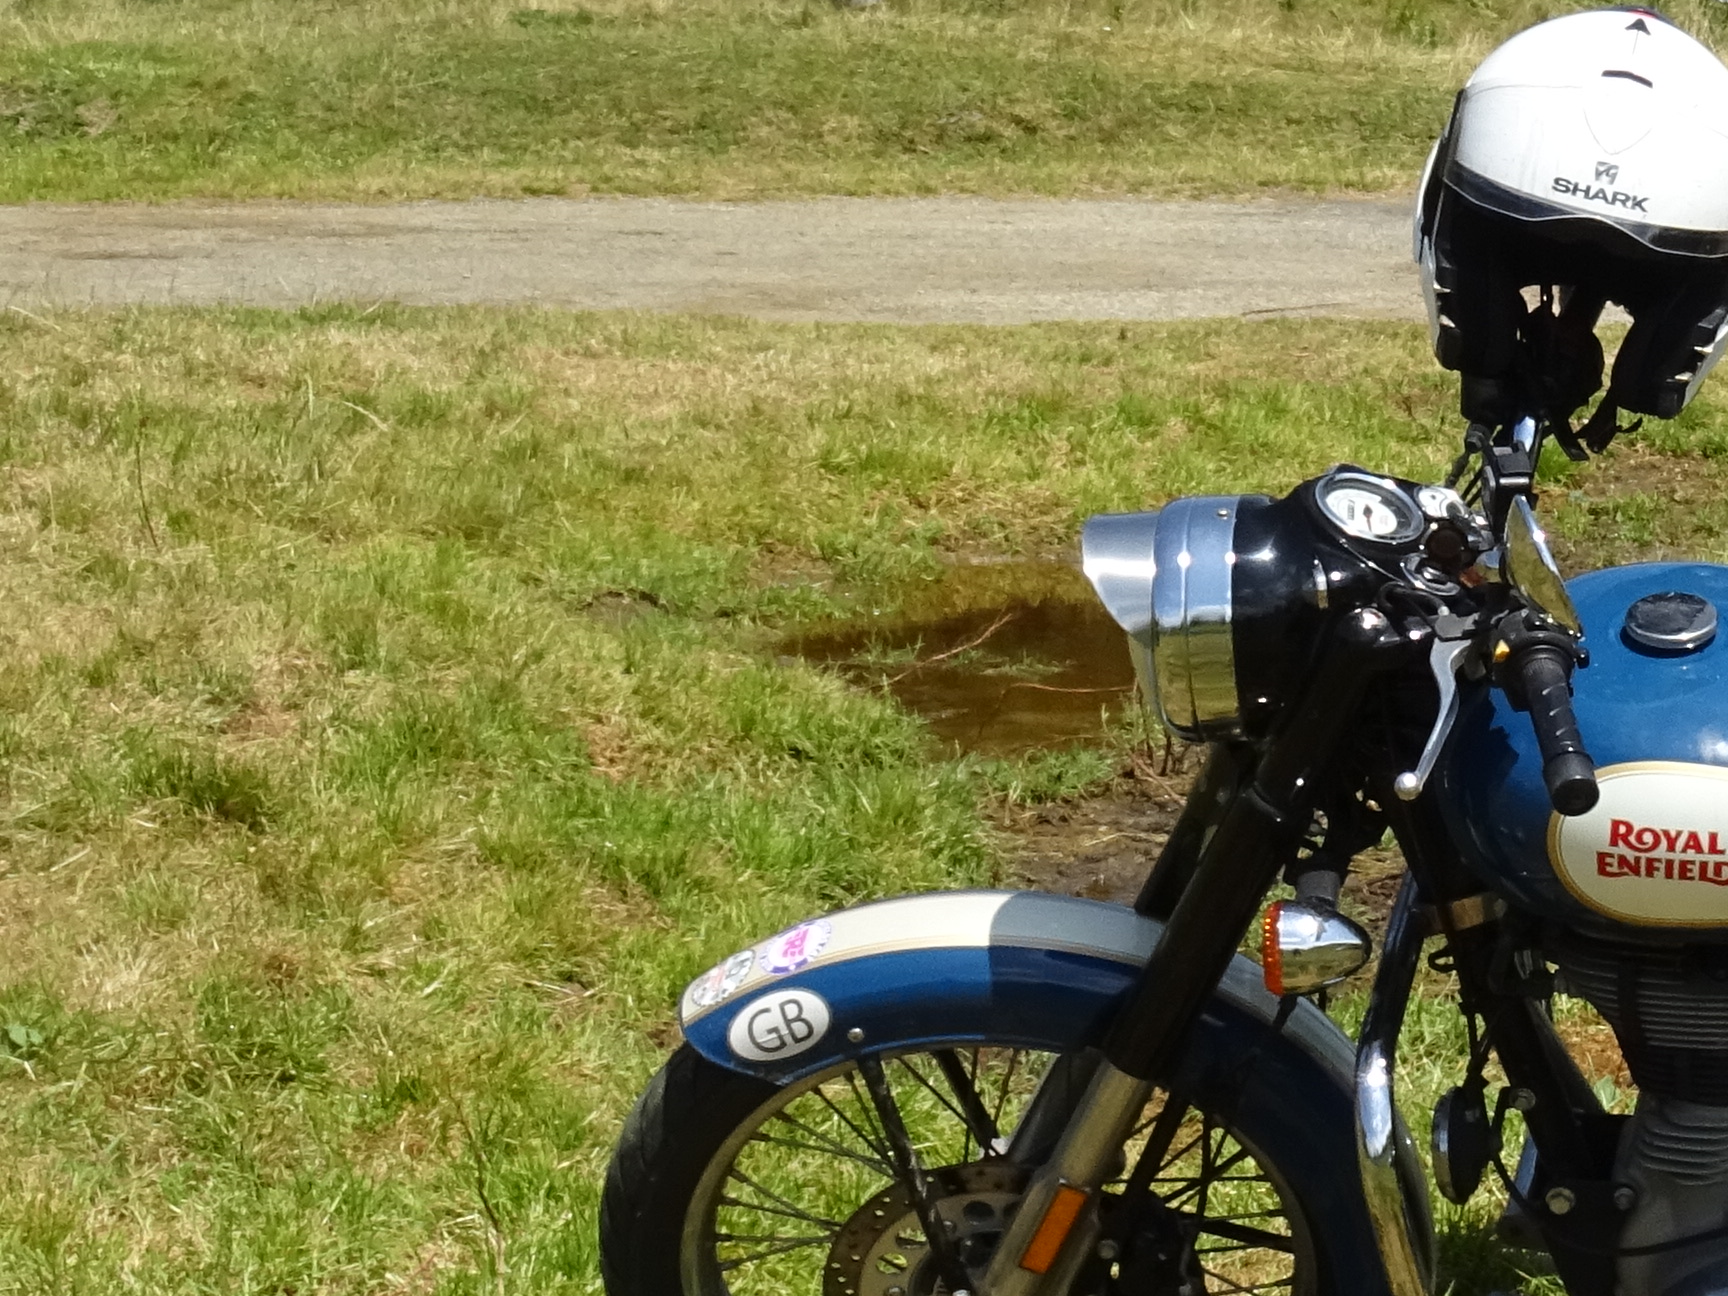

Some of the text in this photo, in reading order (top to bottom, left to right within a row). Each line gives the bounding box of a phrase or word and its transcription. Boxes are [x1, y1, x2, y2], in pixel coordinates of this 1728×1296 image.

[1551, 176, 1650, 214] SHARK
[1609, 819, 1726, 856] ROYAL
[747, 997, 815, 1053] GB
